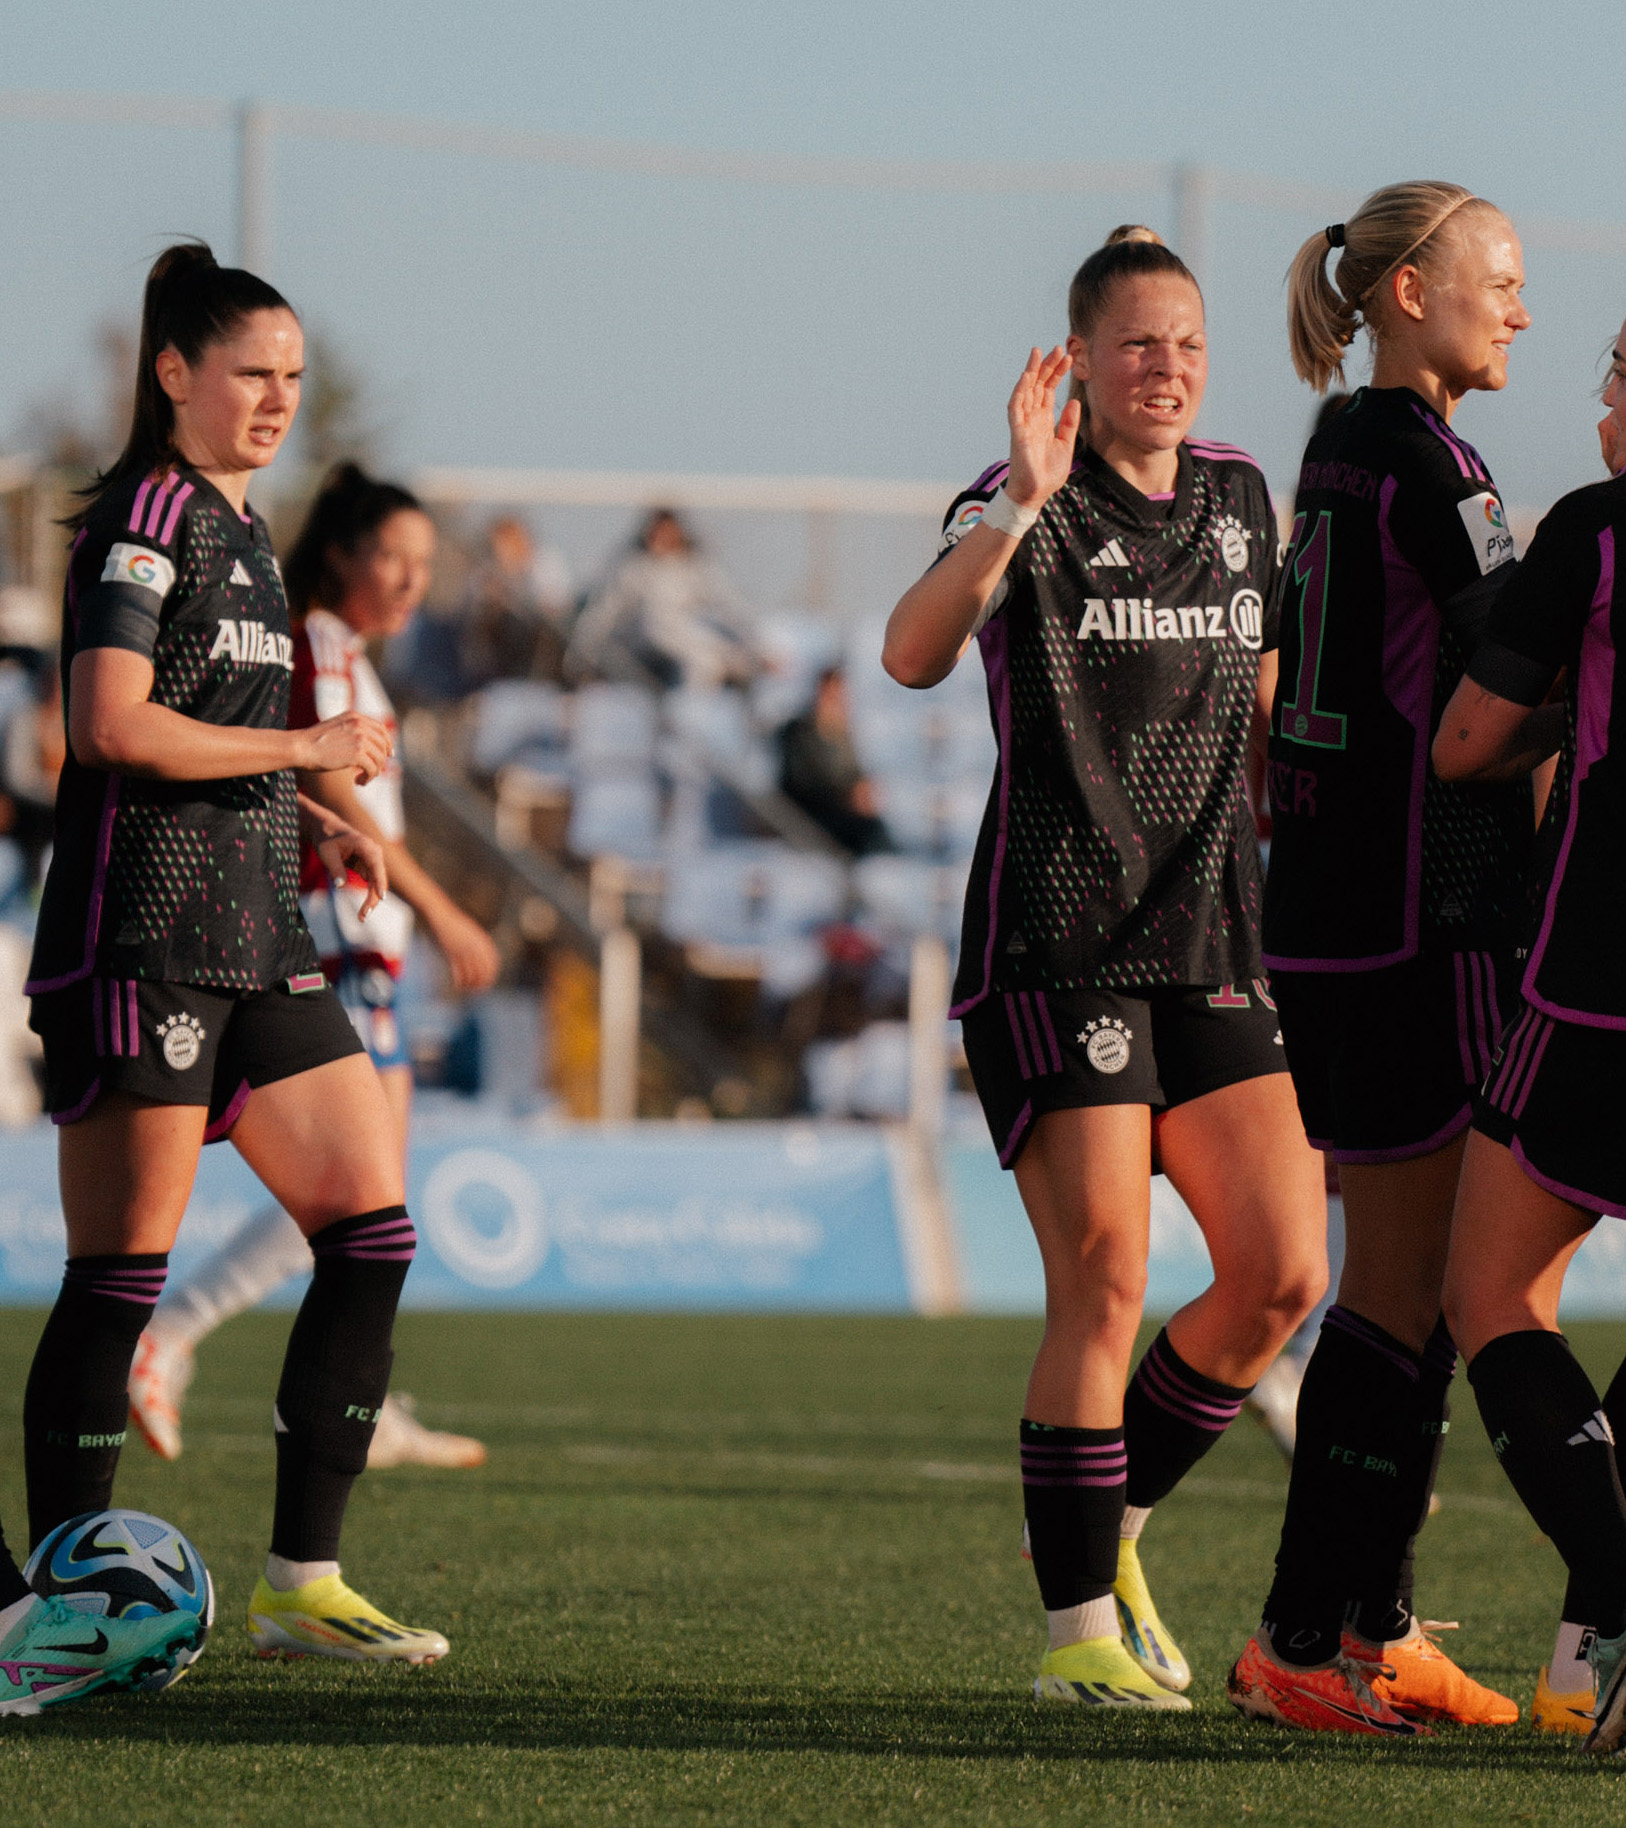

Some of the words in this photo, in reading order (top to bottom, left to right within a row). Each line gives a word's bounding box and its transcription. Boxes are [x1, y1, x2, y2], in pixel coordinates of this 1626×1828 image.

[1076, 597, 1228, 641] Allianz
[208, 618, 296, 672] Allian
[344, 1404, 371, 1422] FC
[1328, 1443, 1359, 1465] FC
